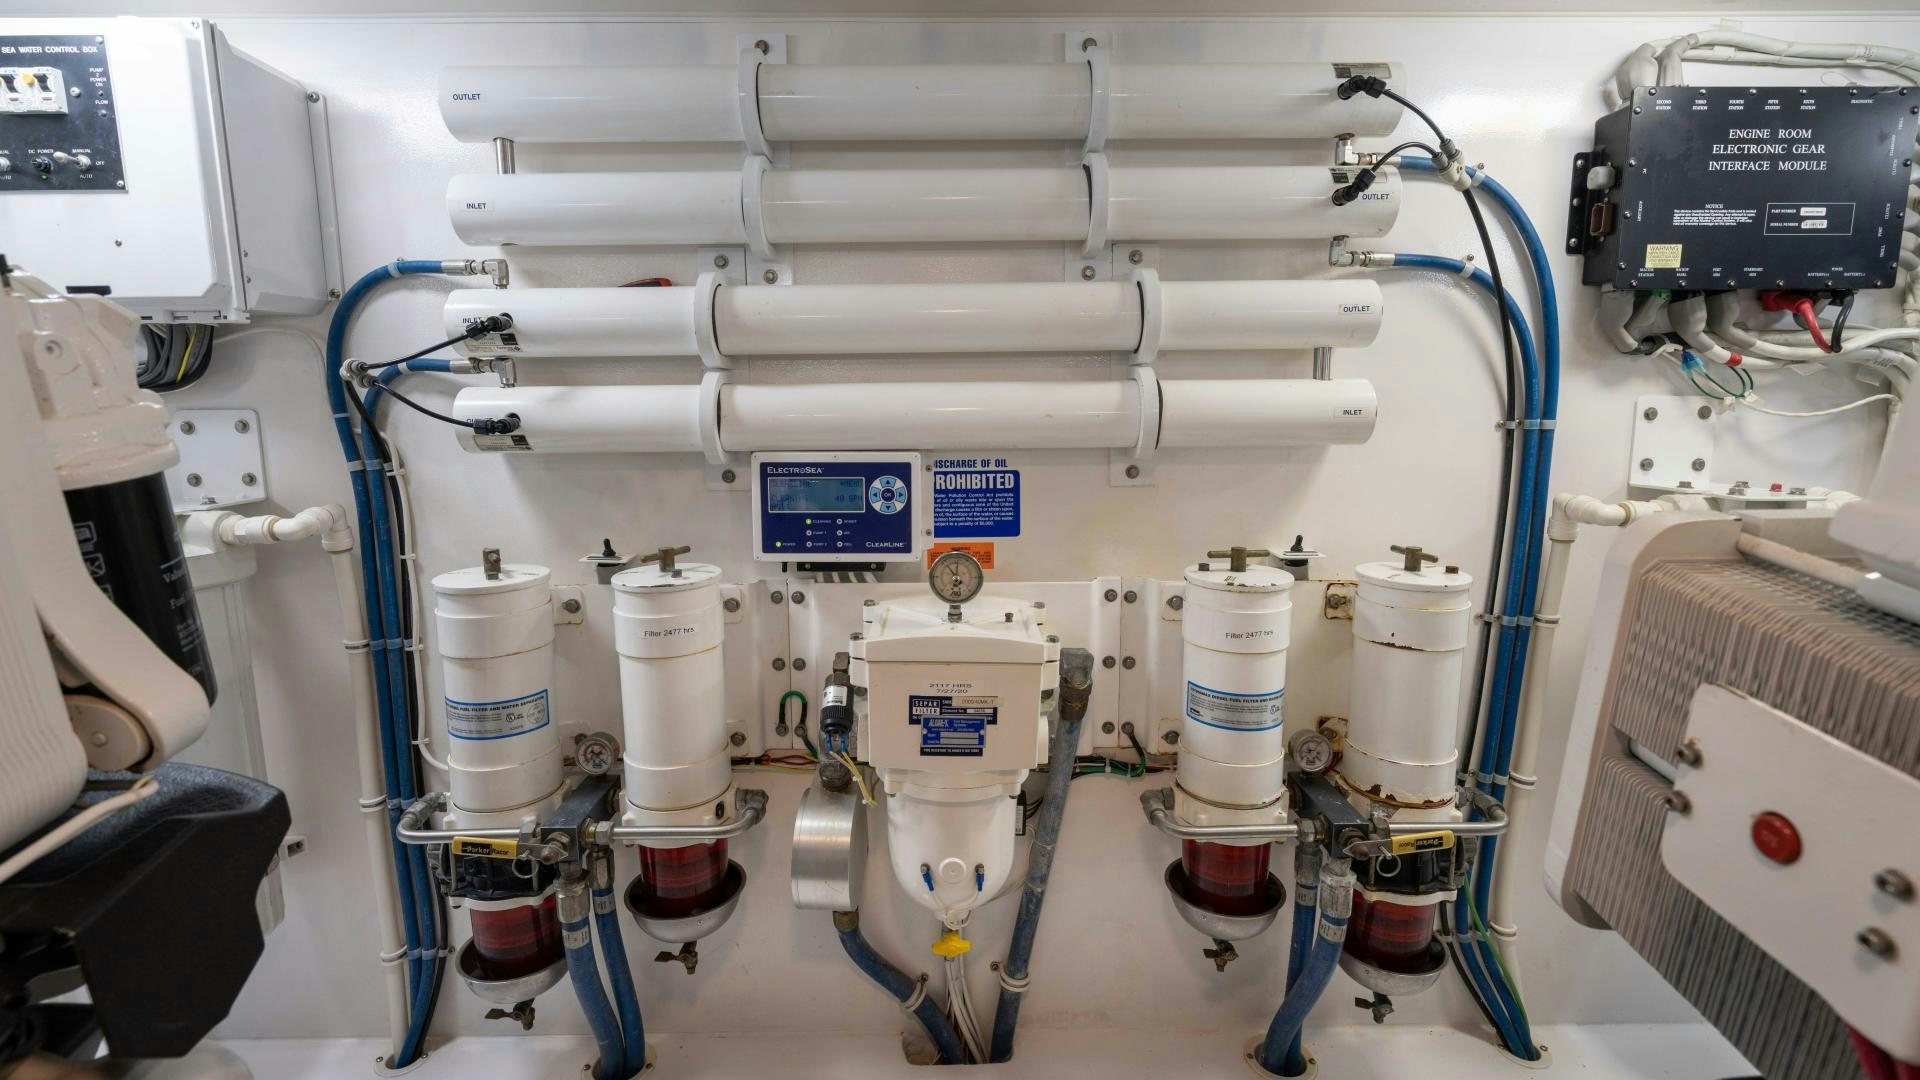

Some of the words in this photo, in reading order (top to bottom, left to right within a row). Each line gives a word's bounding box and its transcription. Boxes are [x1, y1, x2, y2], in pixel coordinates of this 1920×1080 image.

[1728, 129, 1770, 139] ENGINE
[1778, 129, 1812, 139] ROOM
[1712, 144, 1787, 154] ELECTRONIC
[1792, 144, 1825, 154] GEAR
[1708, 161, 1770, 171] INTERFACE
[1778, 161, 1827, 171] MODULE
[981, 459, 991, 468] OF
[995, 459, 1008, 468] OIL
[934, 474, 1014, 490] ROHIBITED
[663, 628, 681, 637] 2477
[1245, 630, 1262, 639] 2477
